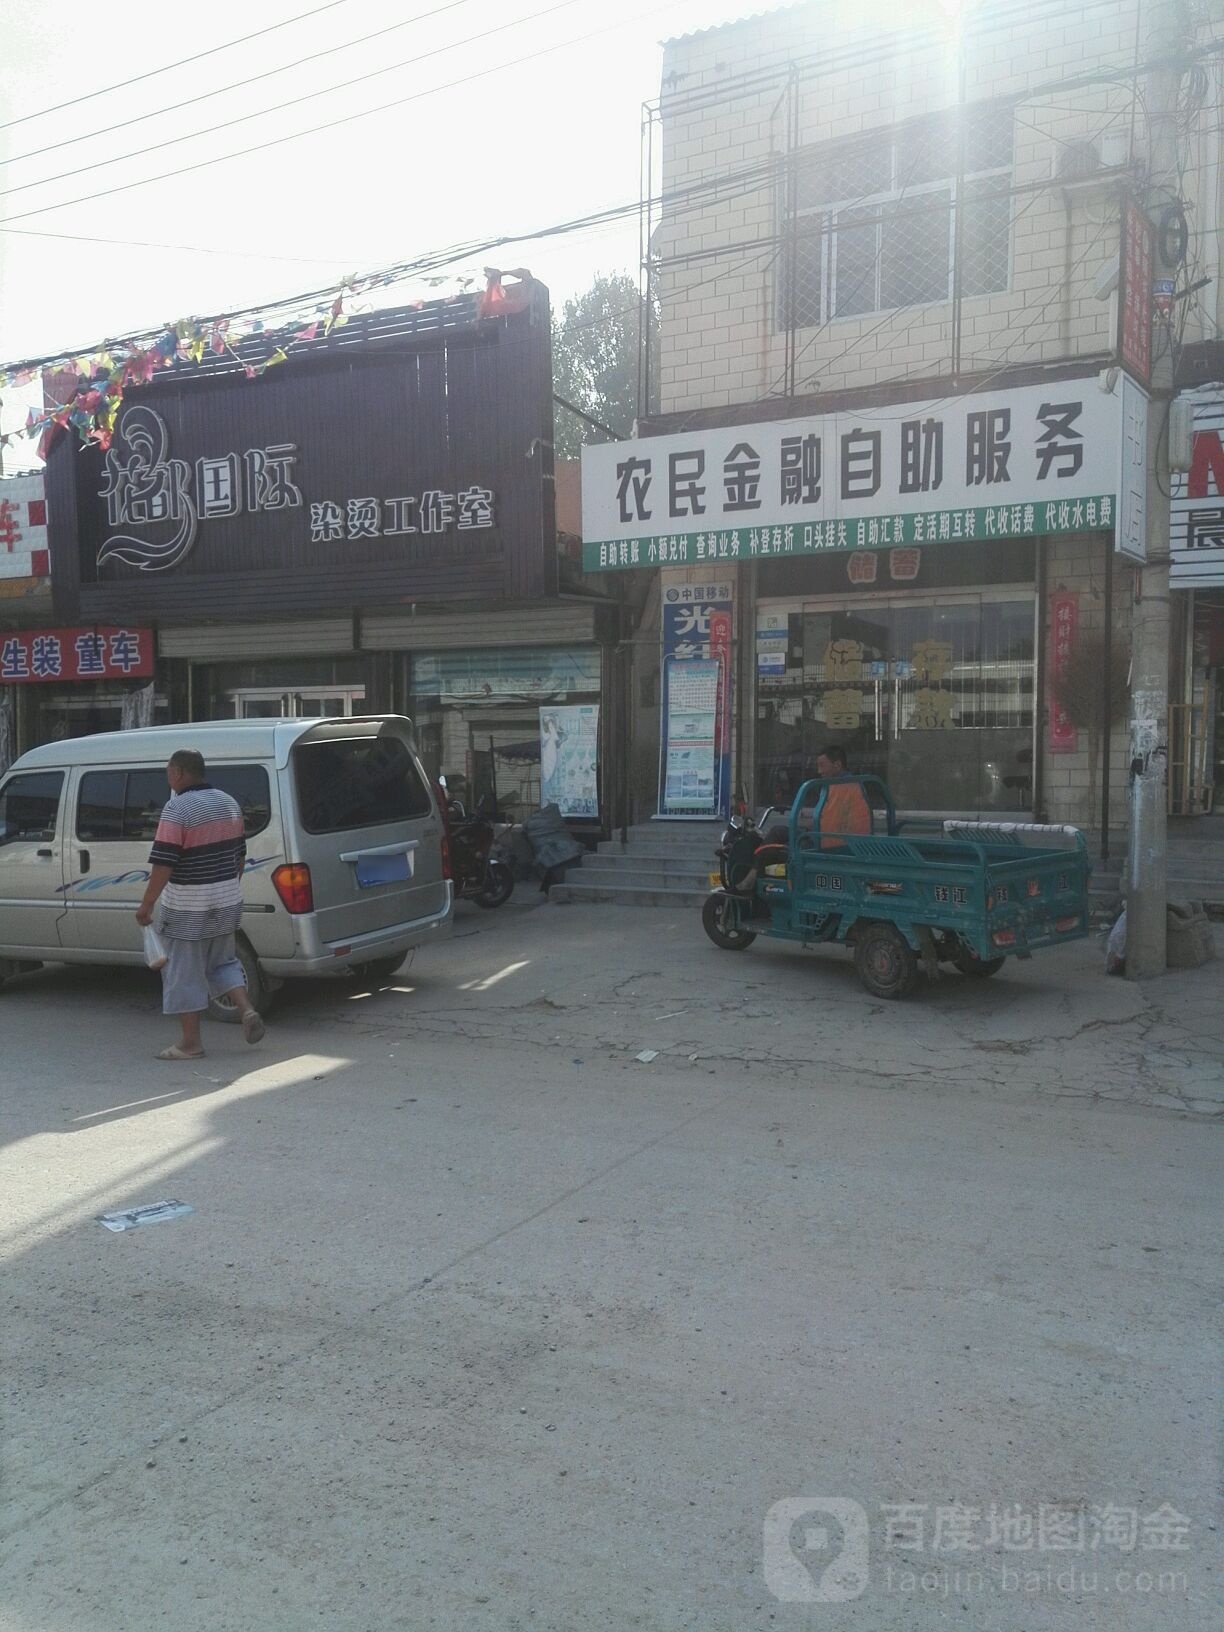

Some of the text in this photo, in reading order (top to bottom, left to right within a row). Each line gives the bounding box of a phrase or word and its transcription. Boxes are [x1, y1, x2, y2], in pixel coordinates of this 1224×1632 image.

[616, 401, 1084, 523] 农民金融自助服务
[310, 486, 494, 542] 染烫工作室
[600, 496, 1112, 566] 自助转账 小额兑付 查询业务 补登存折 口头挂失 自助汇款 定活期互转 代收话费 代收水电费
[681, 585, 730, 602] 中国移动
[1, 631, 141, 678] 生装 童车
